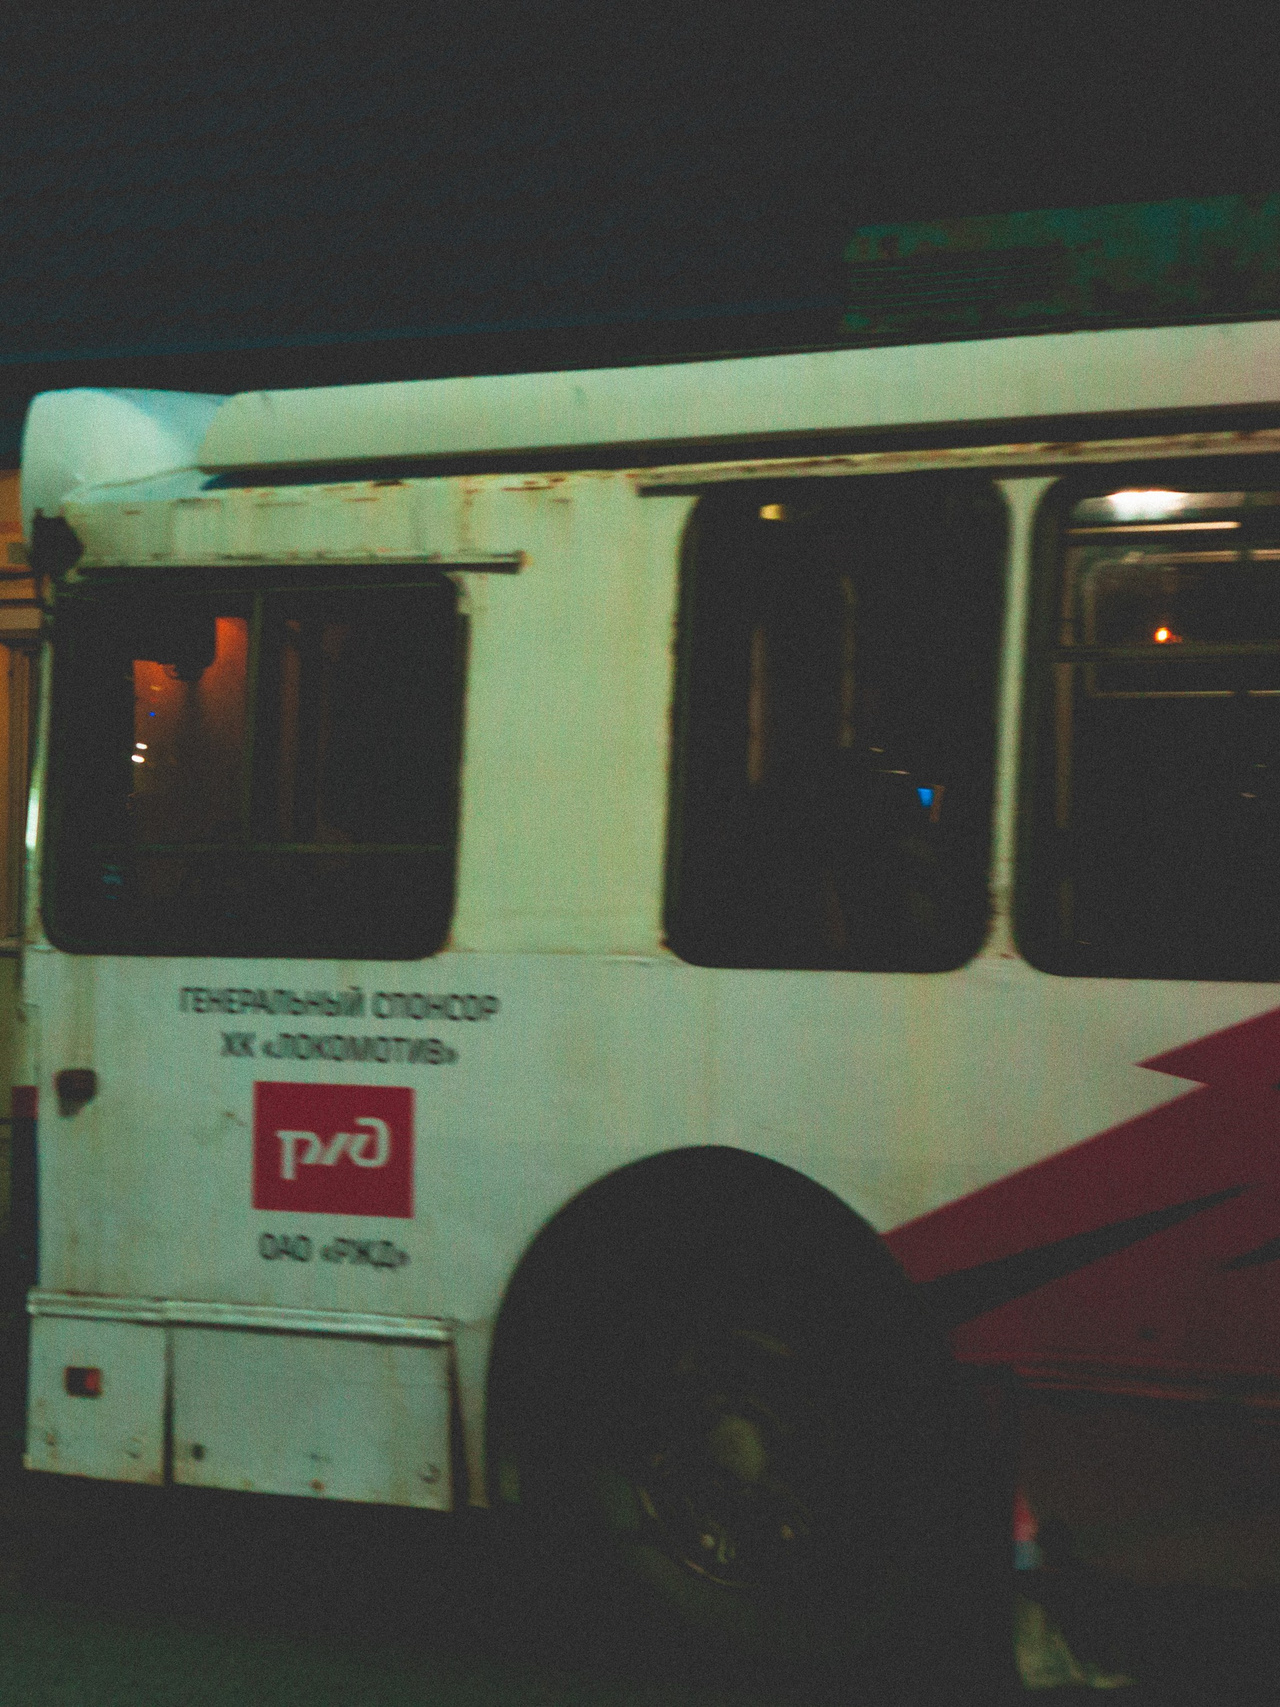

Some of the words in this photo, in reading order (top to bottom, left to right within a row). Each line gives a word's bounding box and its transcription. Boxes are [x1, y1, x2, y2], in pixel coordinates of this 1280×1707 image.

[180, 985, 364, 1016] ГЕНЕРАЛЬНЫЙ
[372, 991, 500, 1021] СПОНСОР
[221, 1031, 256, 1057] ХК
[258, 1232, 313, 1262] ОАО
